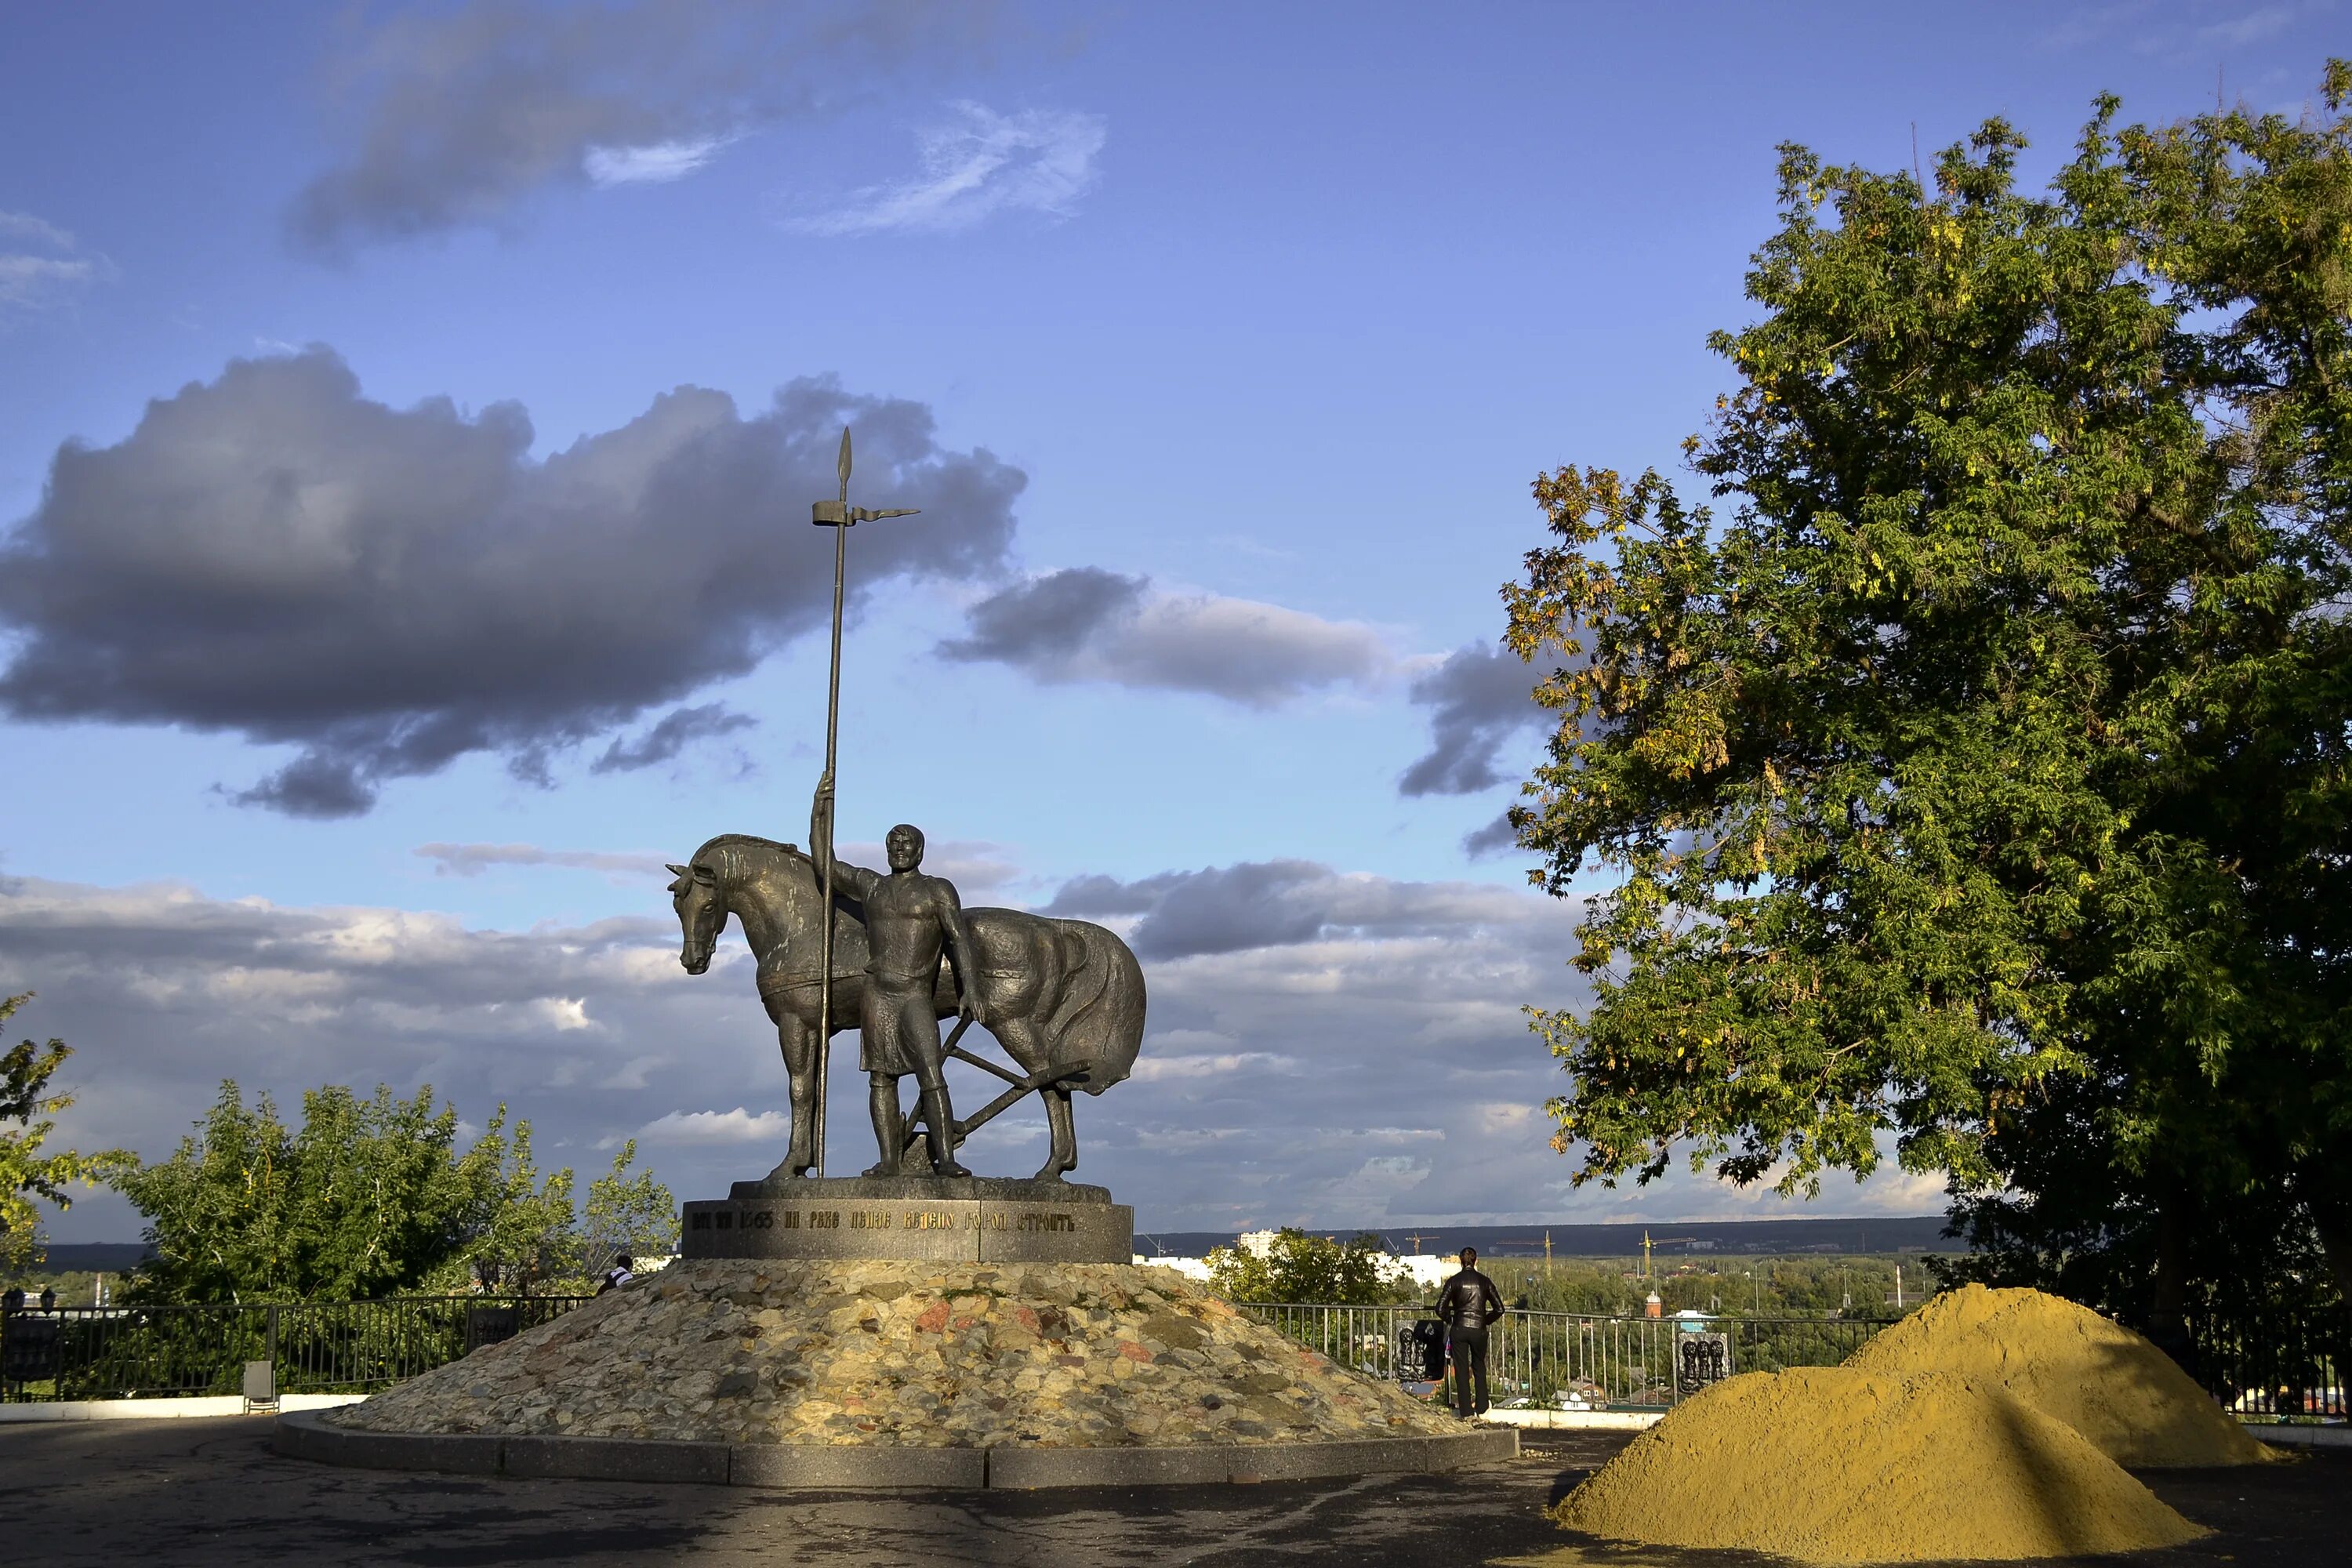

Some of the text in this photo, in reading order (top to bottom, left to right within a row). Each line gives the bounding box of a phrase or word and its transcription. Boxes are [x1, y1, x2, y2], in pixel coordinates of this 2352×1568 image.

[809, 1210, 840, 1229] РЕКЕ
[903, 1211, 955, 1230] ВЕЛЕНО
[964, 1211, 1007, 1231] ГОРОД
